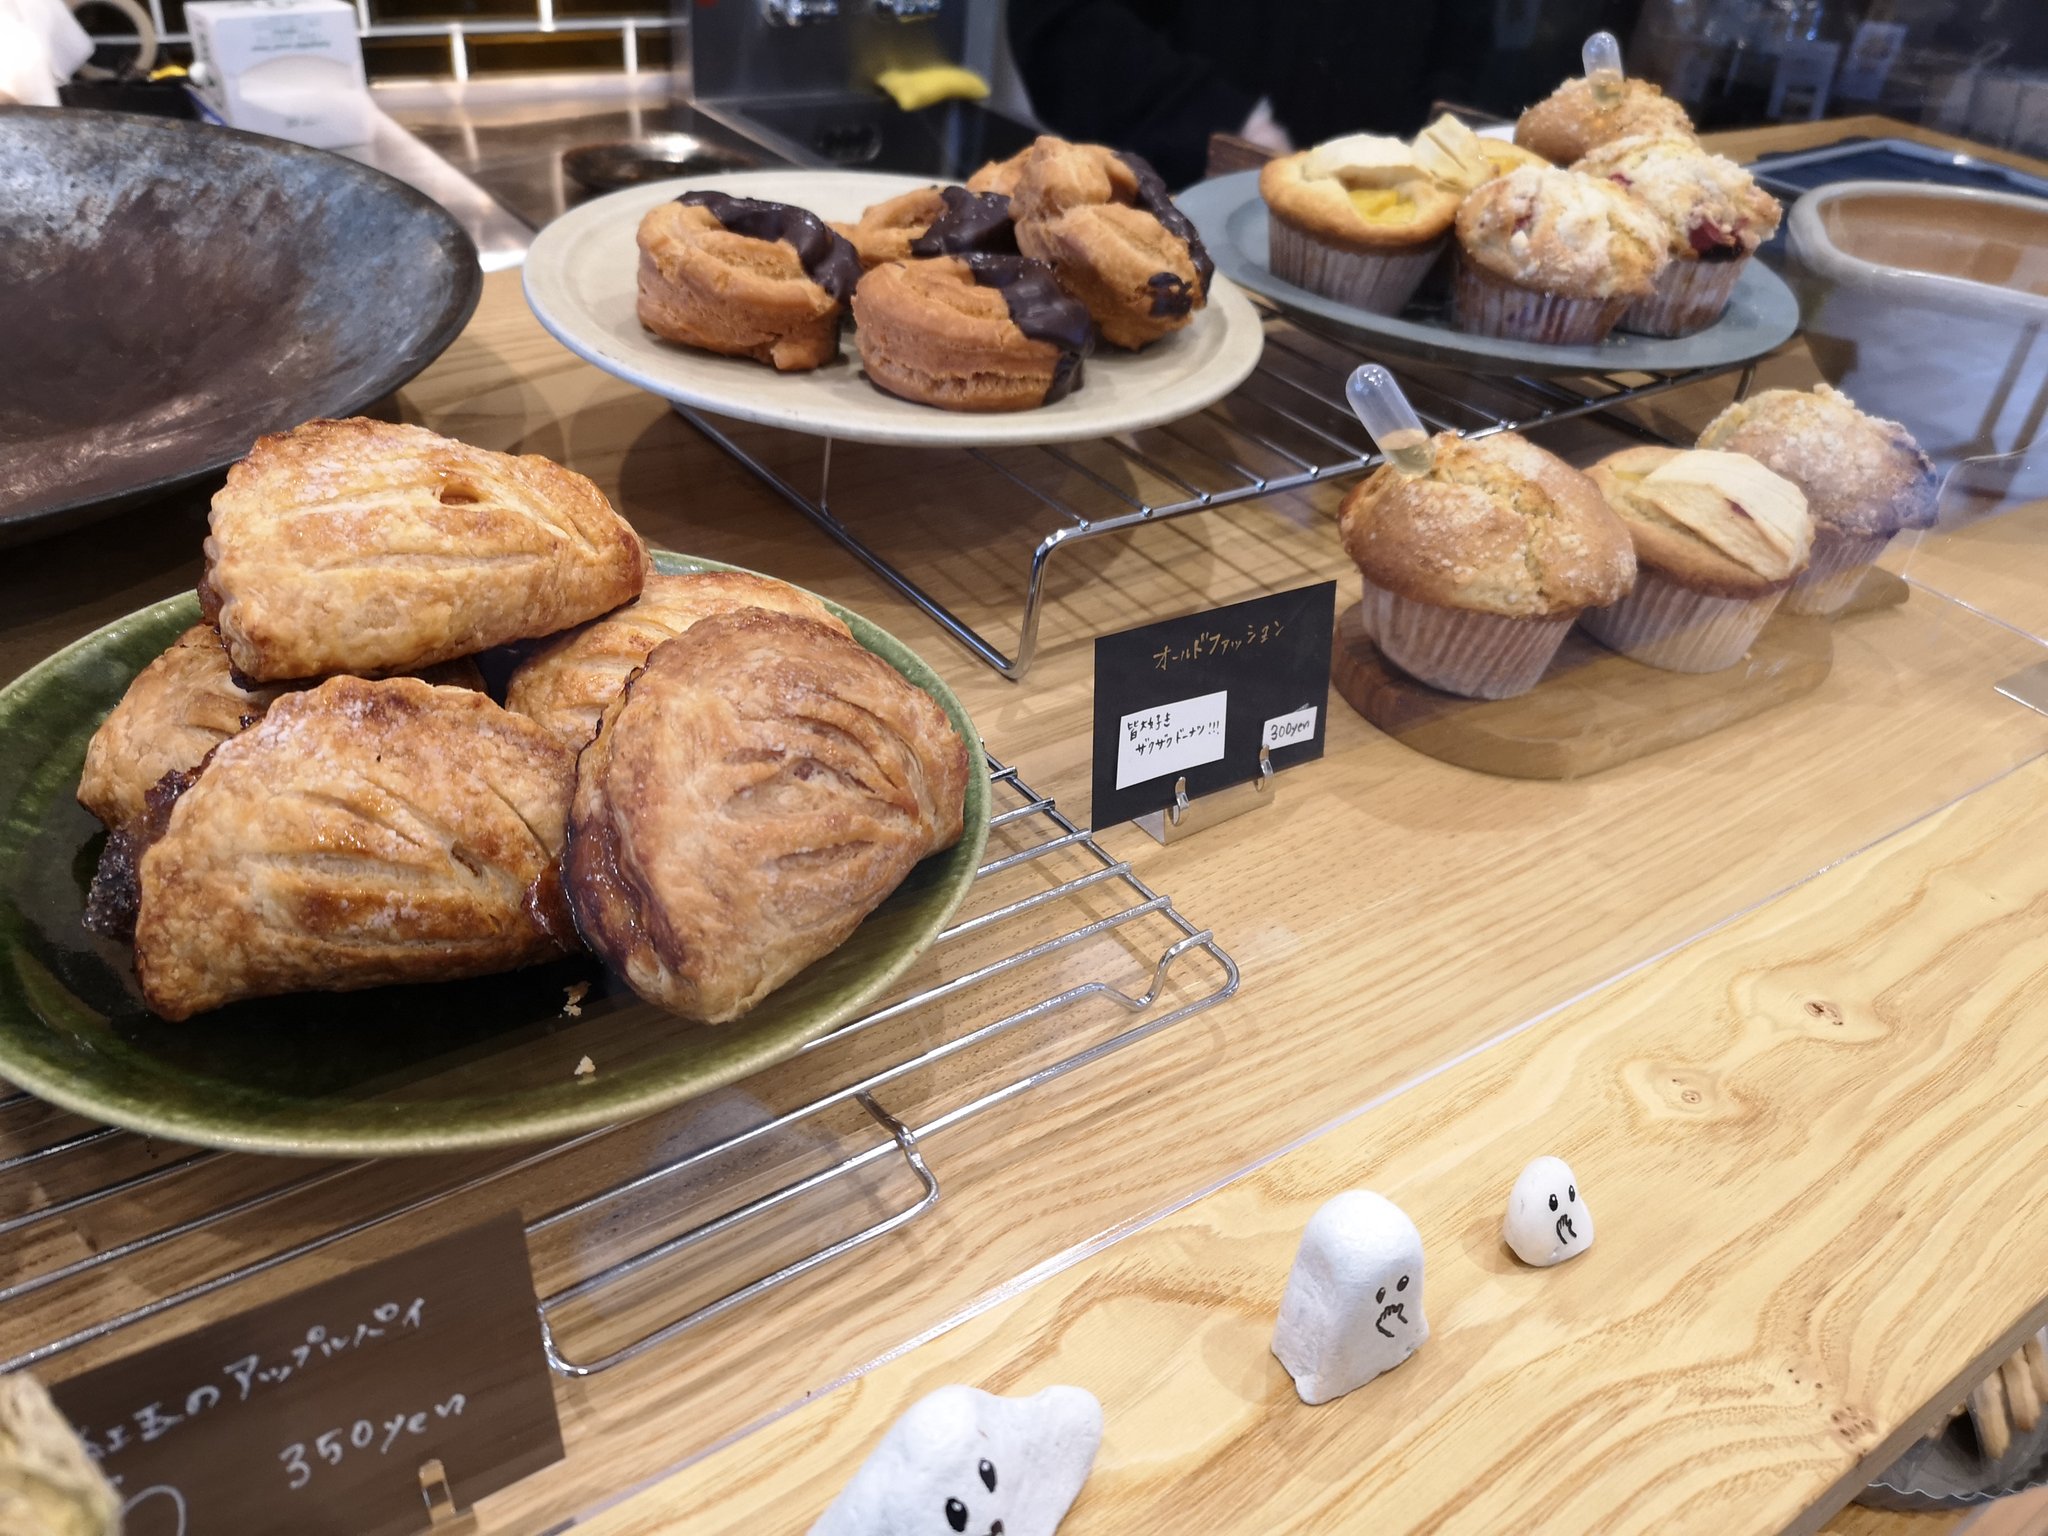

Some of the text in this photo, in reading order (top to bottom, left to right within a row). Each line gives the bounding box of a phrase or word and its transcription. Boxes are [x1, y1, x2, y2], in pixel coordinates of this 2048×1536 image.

[1152, 620, 1285, 671] オールドファッション
[1126, 712, 1171, 742] 皆大好き
[1270, 719, 1311, 741] 300yen
[279, 1393, 467, 1490] 350yen
